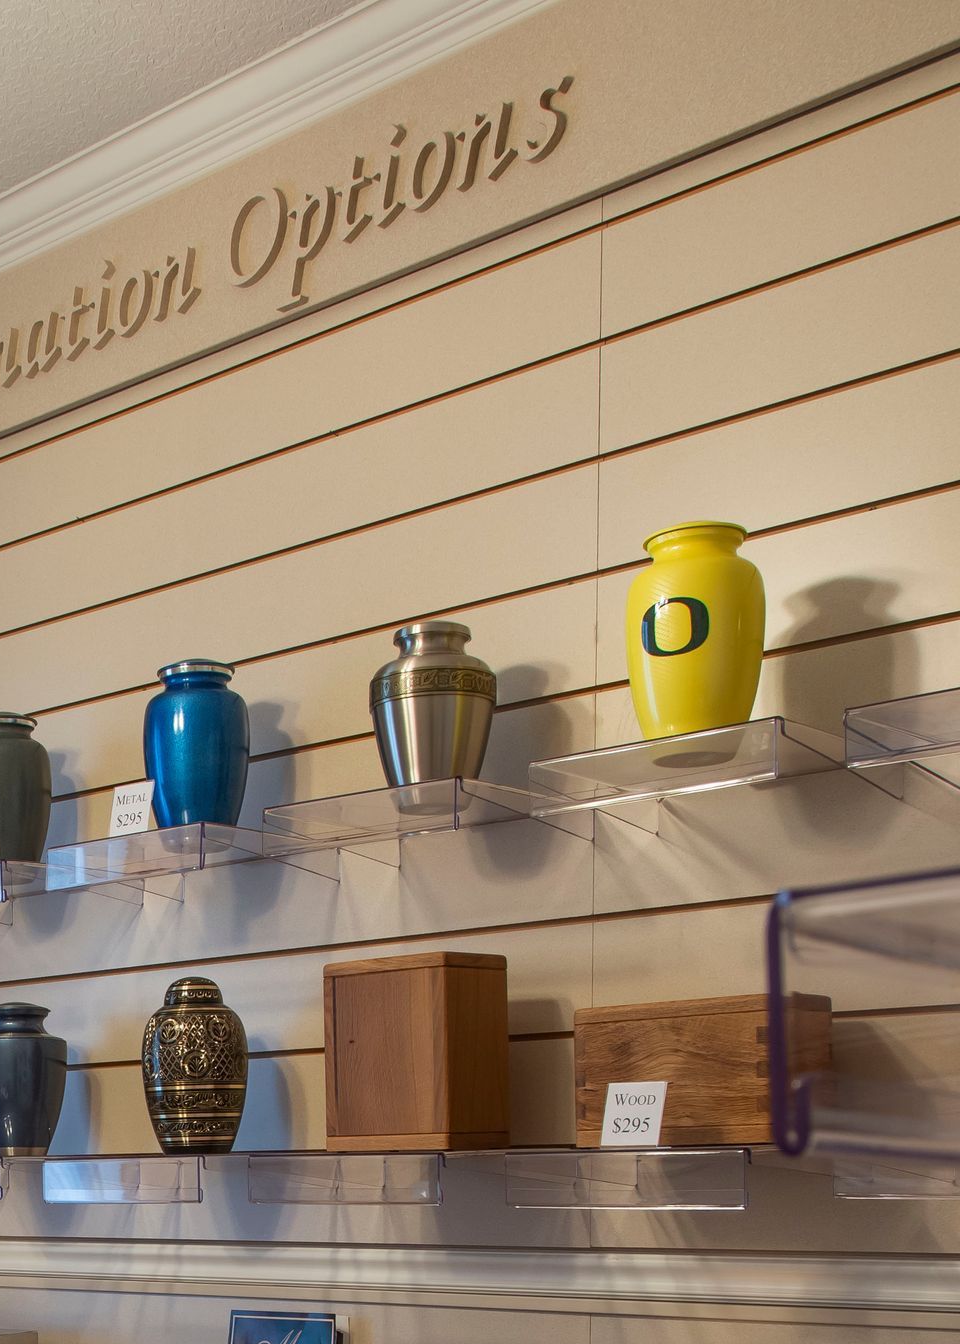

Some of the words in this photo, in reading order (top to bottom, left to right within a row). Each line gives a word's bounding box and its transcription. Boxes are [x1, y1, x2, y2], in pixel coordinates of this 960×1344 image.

[230, 75, 575, 313] Options
[641, 596, 709, 656] O
[116, 793, 147, 806] METAL
[116, 811, 143, 828] $295
[615, 1093, 656, 1106] WOOD
[612, 1116, 650, 1134] $295
